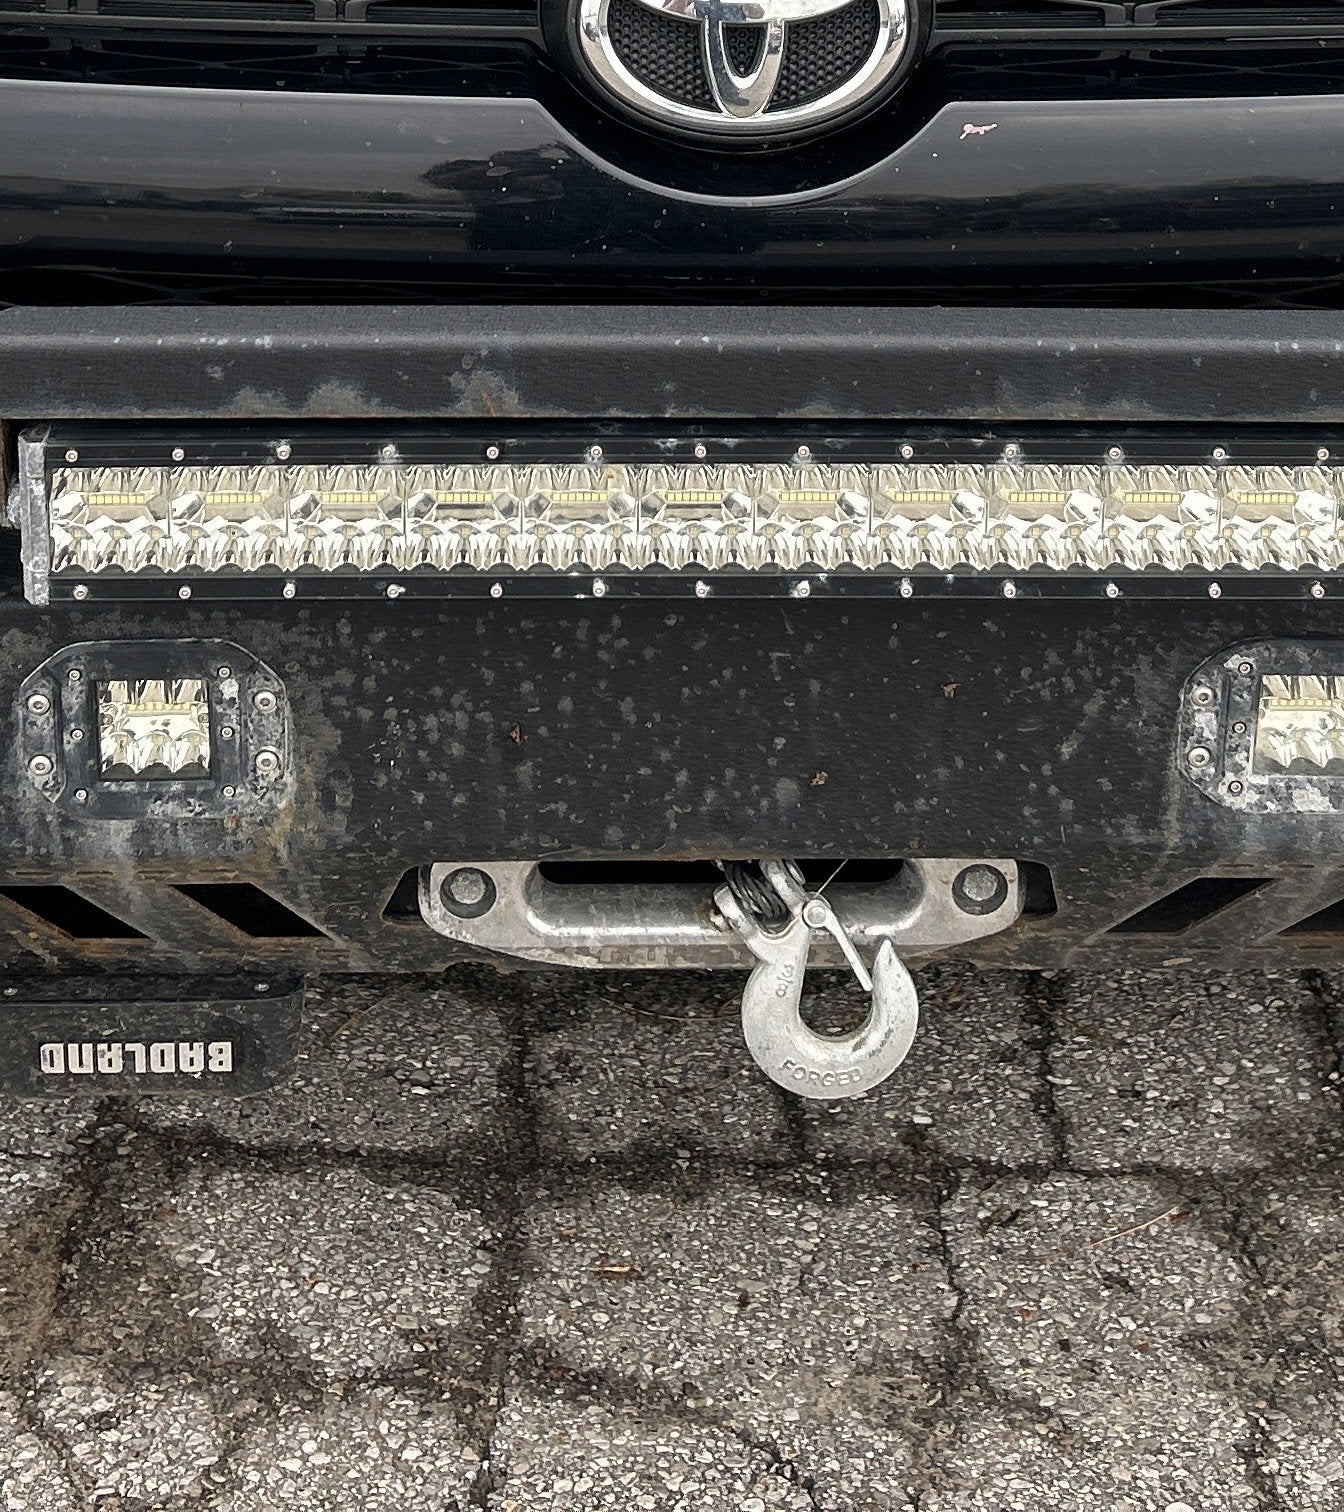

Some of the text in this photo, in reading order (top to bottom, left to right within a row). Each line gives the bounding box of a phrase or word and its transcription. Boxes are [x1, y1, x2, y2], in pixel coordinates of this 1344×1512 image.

[775, 963, 795, 999] 3/8
[39, 1041, 234, 1075] BADLAND
[779, 1057, 862, 1086] FORGED
